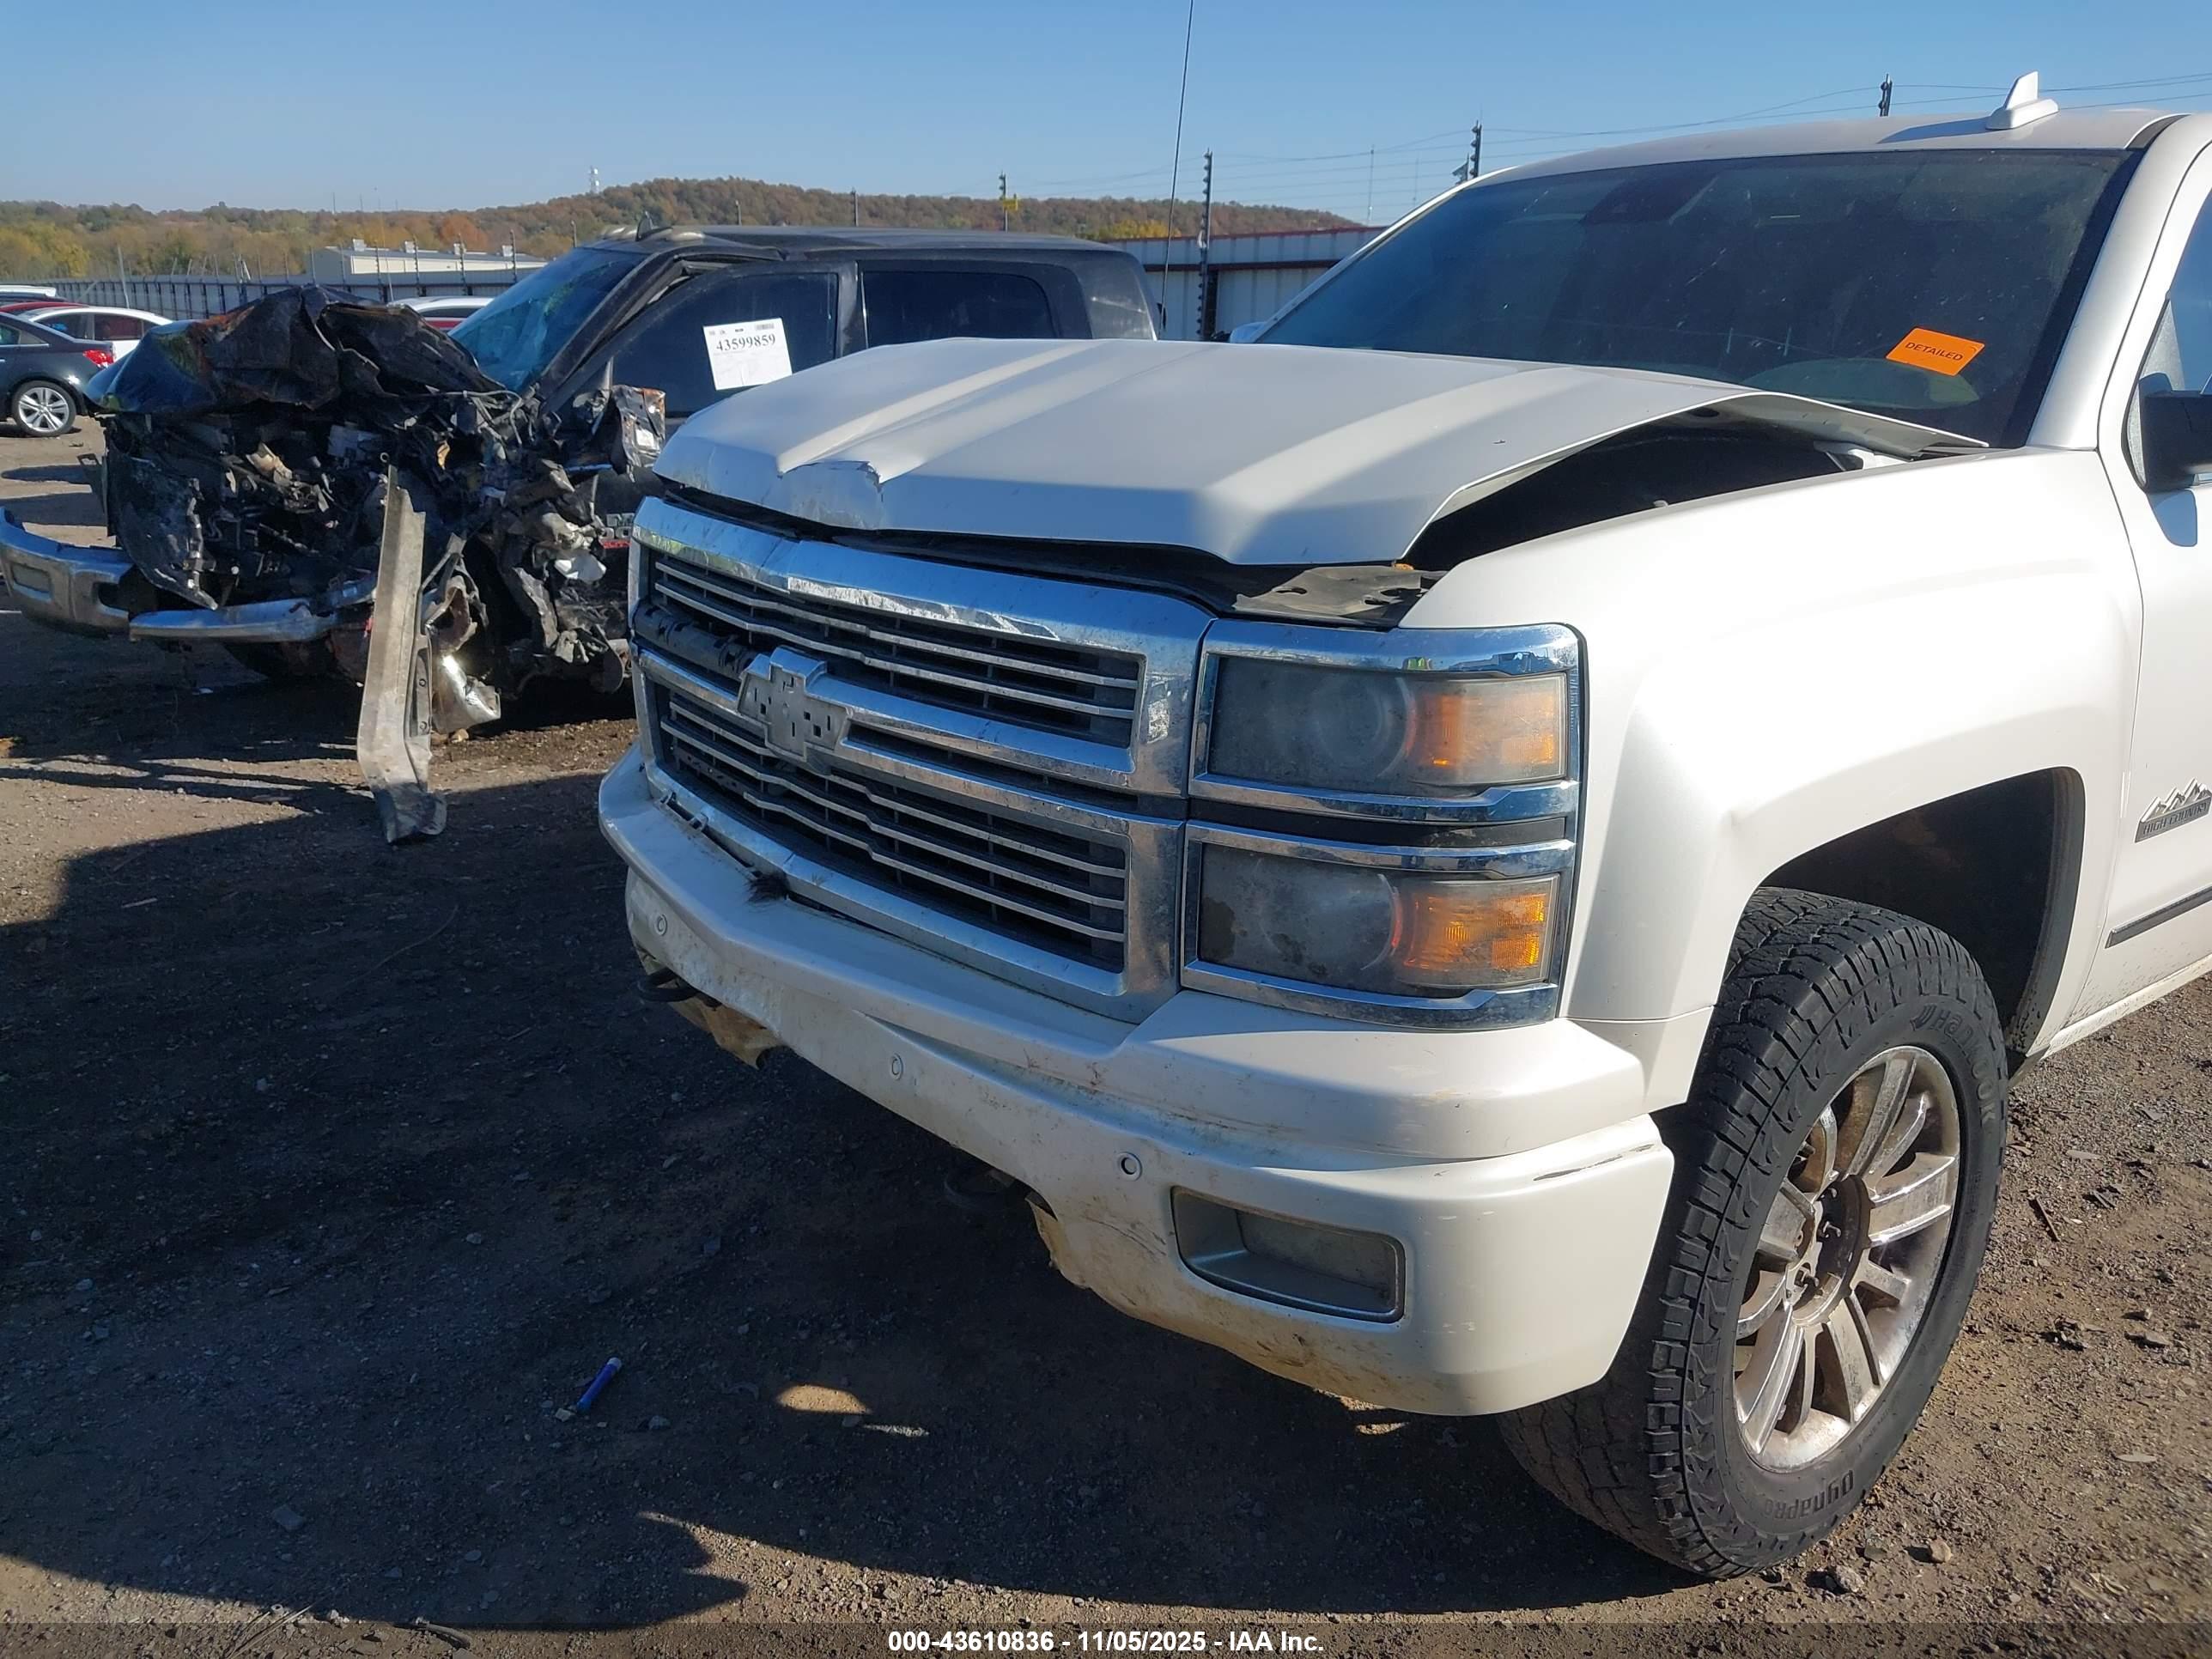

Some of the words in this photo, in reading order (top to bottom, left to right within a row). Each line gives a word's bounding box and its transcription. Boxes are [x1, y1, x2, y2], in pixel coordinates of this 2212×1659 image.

[716, 333, 776, 351] 43599859
[1905, 342, 1964, 362] DETAILED
[2142, 817, 2167, 835] HIGH
[2169, 803, 2207, 825] COUNTRY
